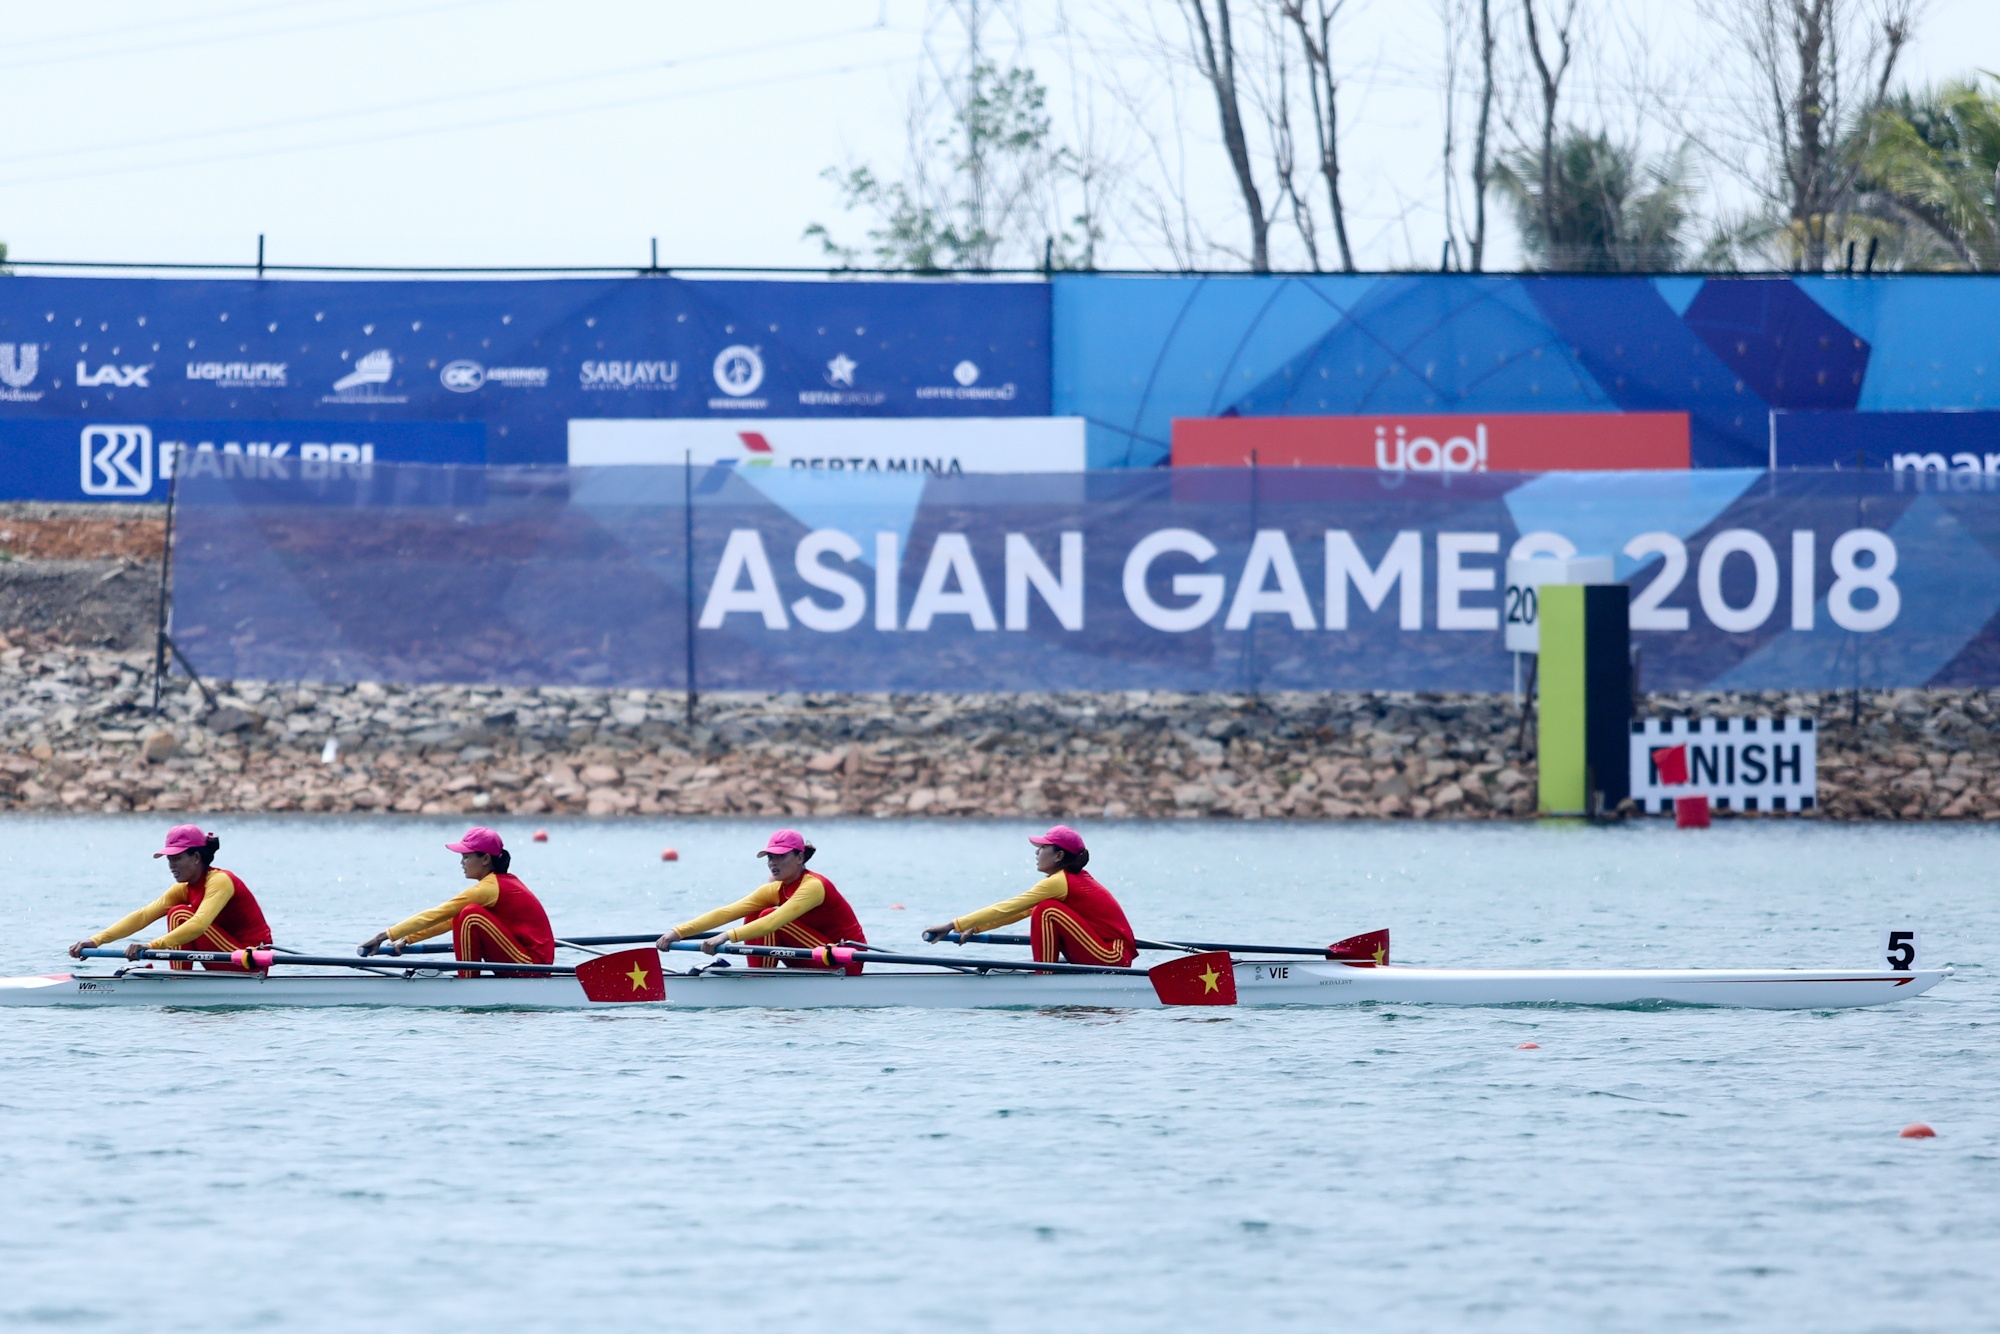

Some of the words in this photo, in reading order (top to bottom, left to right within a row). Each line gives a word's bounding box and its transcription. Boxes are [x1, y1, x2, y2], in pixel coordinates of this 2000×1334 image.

[76, 360, 150, 388] LAX
[159, 442, 290, 479] BANK
[300, 443, 373, 479] BRI
[698, 529, 1083, 632] ASIAN
[1122, 528, 1576, 632] GAME
[1623, 529, 1900, 632] 2018
[1649, 744, 1800, 786] FNISH
[1886, 931, 1915, 967] 5
[1269, 967, 1288, 979] VIE
